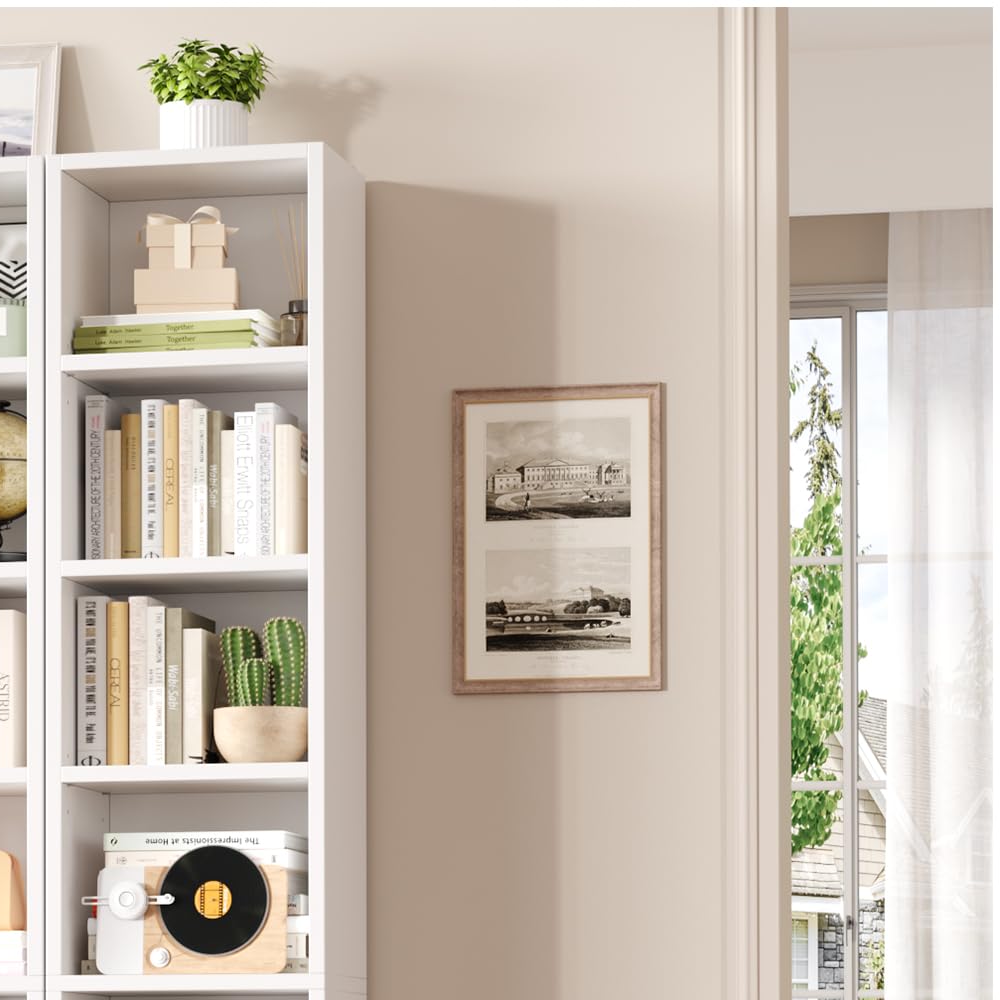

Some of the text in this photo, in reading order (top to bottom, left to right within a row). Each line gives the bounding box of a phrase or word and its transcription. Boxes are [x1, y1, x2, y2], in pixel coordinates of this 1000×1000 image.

[165, 324, 194, 334] Together
[167, 335, 196, 346] Together
[166, 458, 175, 511] CEREAL
[237, 415, 254, 545] Elliott Erwitt Snaps
[109, 657, 121, 714] CEREAL
[168, 664, 179, 711] Wabi-Sabi
[145, 837, 169, 845] Home
[181, 836, 242, 845] Impressionists
[245, 837, 260, 845] The
